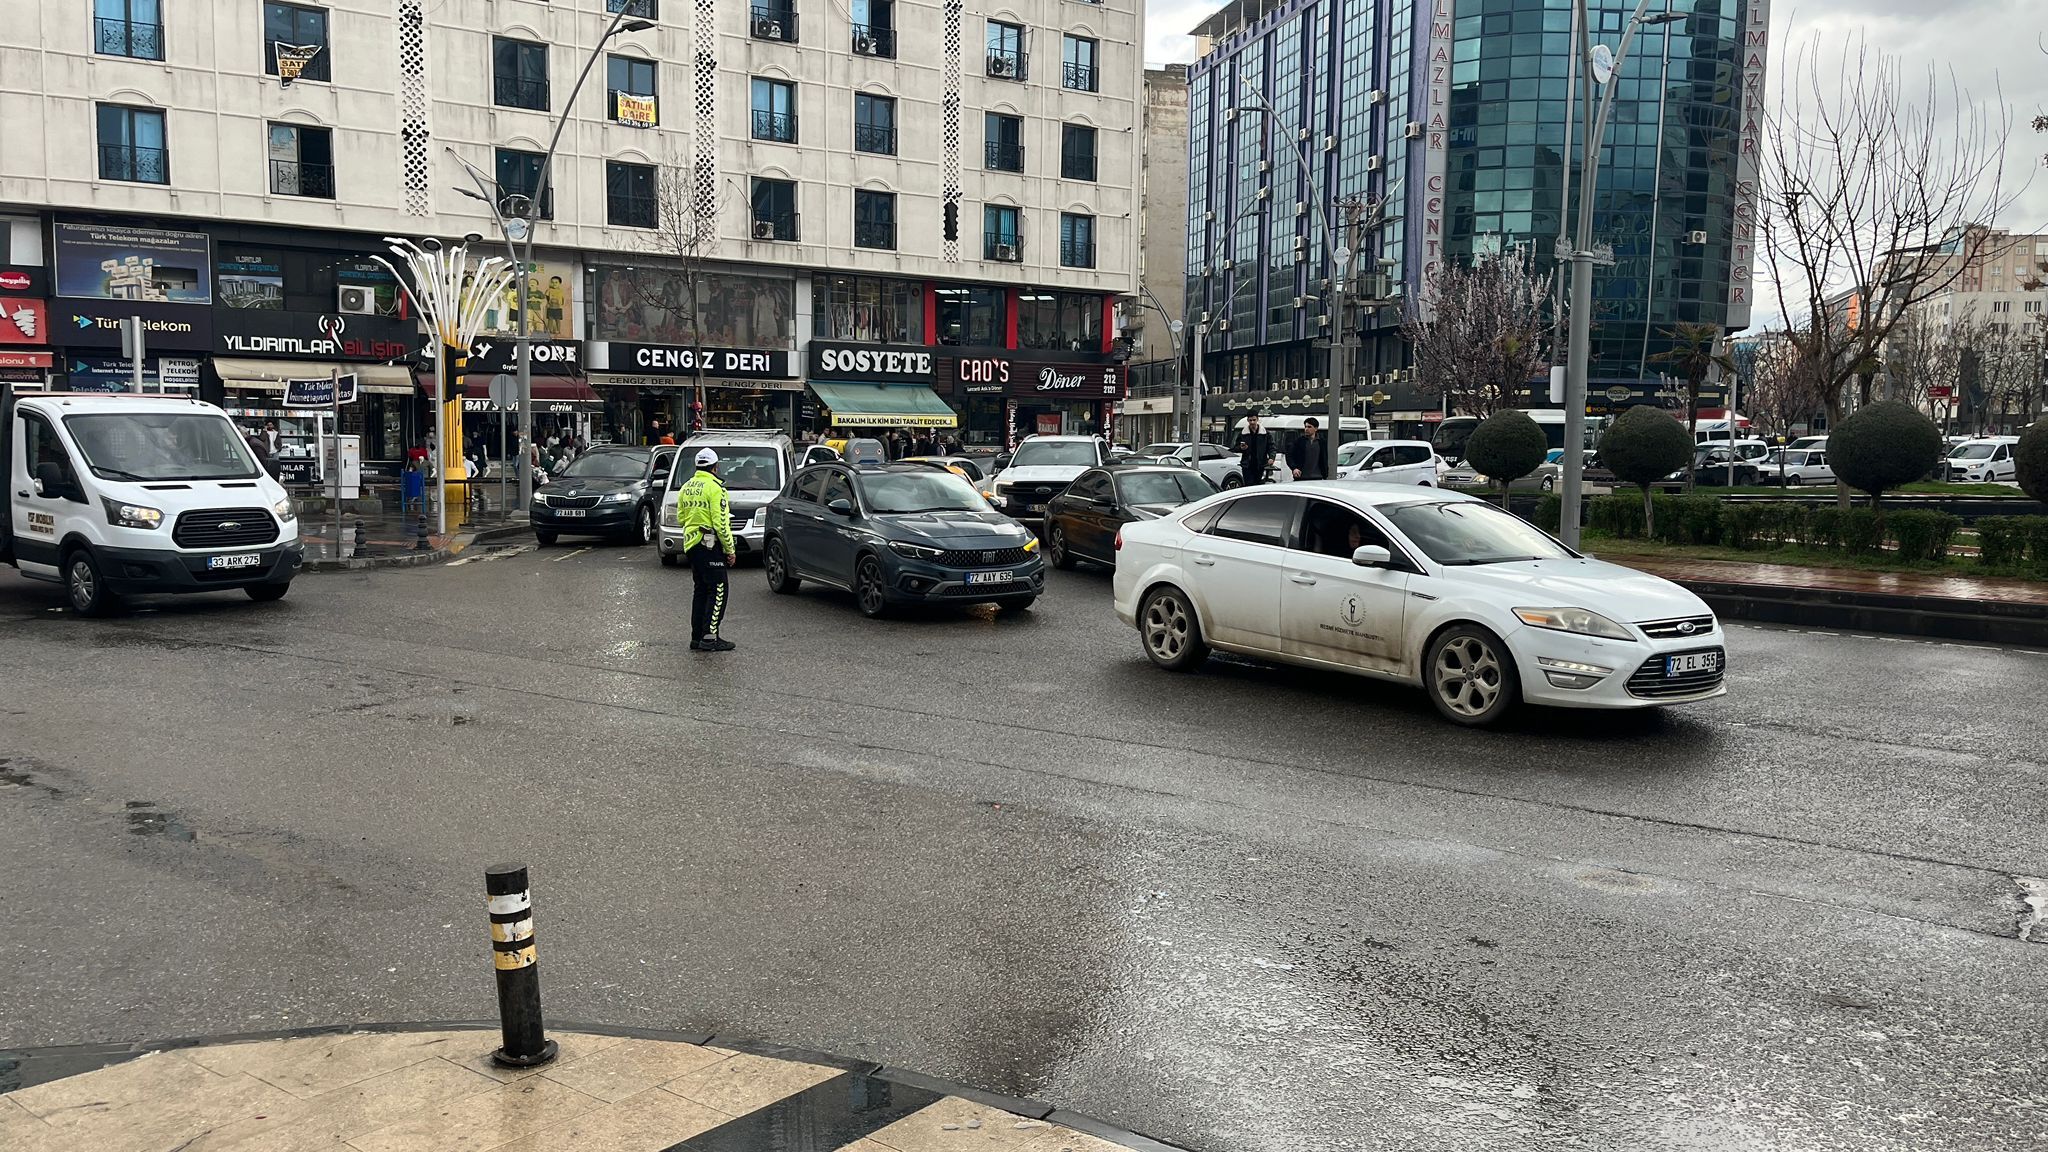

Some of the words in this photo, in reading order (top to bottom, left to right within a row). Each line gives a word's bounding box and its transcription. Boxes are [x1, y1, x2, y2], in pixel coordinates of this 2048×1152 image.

[620, 99, 653, 112] SATILIK
[108, 234, 138, 242] Telekom
[224, 335, 334, 354] YILDIRIMLAR
[726, 351, 770, 372] DERİ
[821, 348, 931, 374] SOSYETE
[609, 377, 646, 385] CENGİZ
[651, 378, 674, 386] DERİ
[1036, 367, 1086, 391] Döner
[1103, 374, 1116, 384] 212
[721, 380, 756, 388] CENGİZ
[761, 382, 783, 390] DERİ
[465, 401, 489, 411] BAY
[550, 402, 573, 412] GİYİM
[212, 558, 224, 567] 33
[227, 556, 243, 566] ARK
[243, 556, 259, 565] 275
[970, 574, 979, 583] 72
[983, 572, 998, 582] AAY
[1000, 571, 1012, 581] 635
[1671, 658, 1682, 671] 72
[1686, 656, 1697, 670] EL
[1701, 653, 1716, 668] 355
